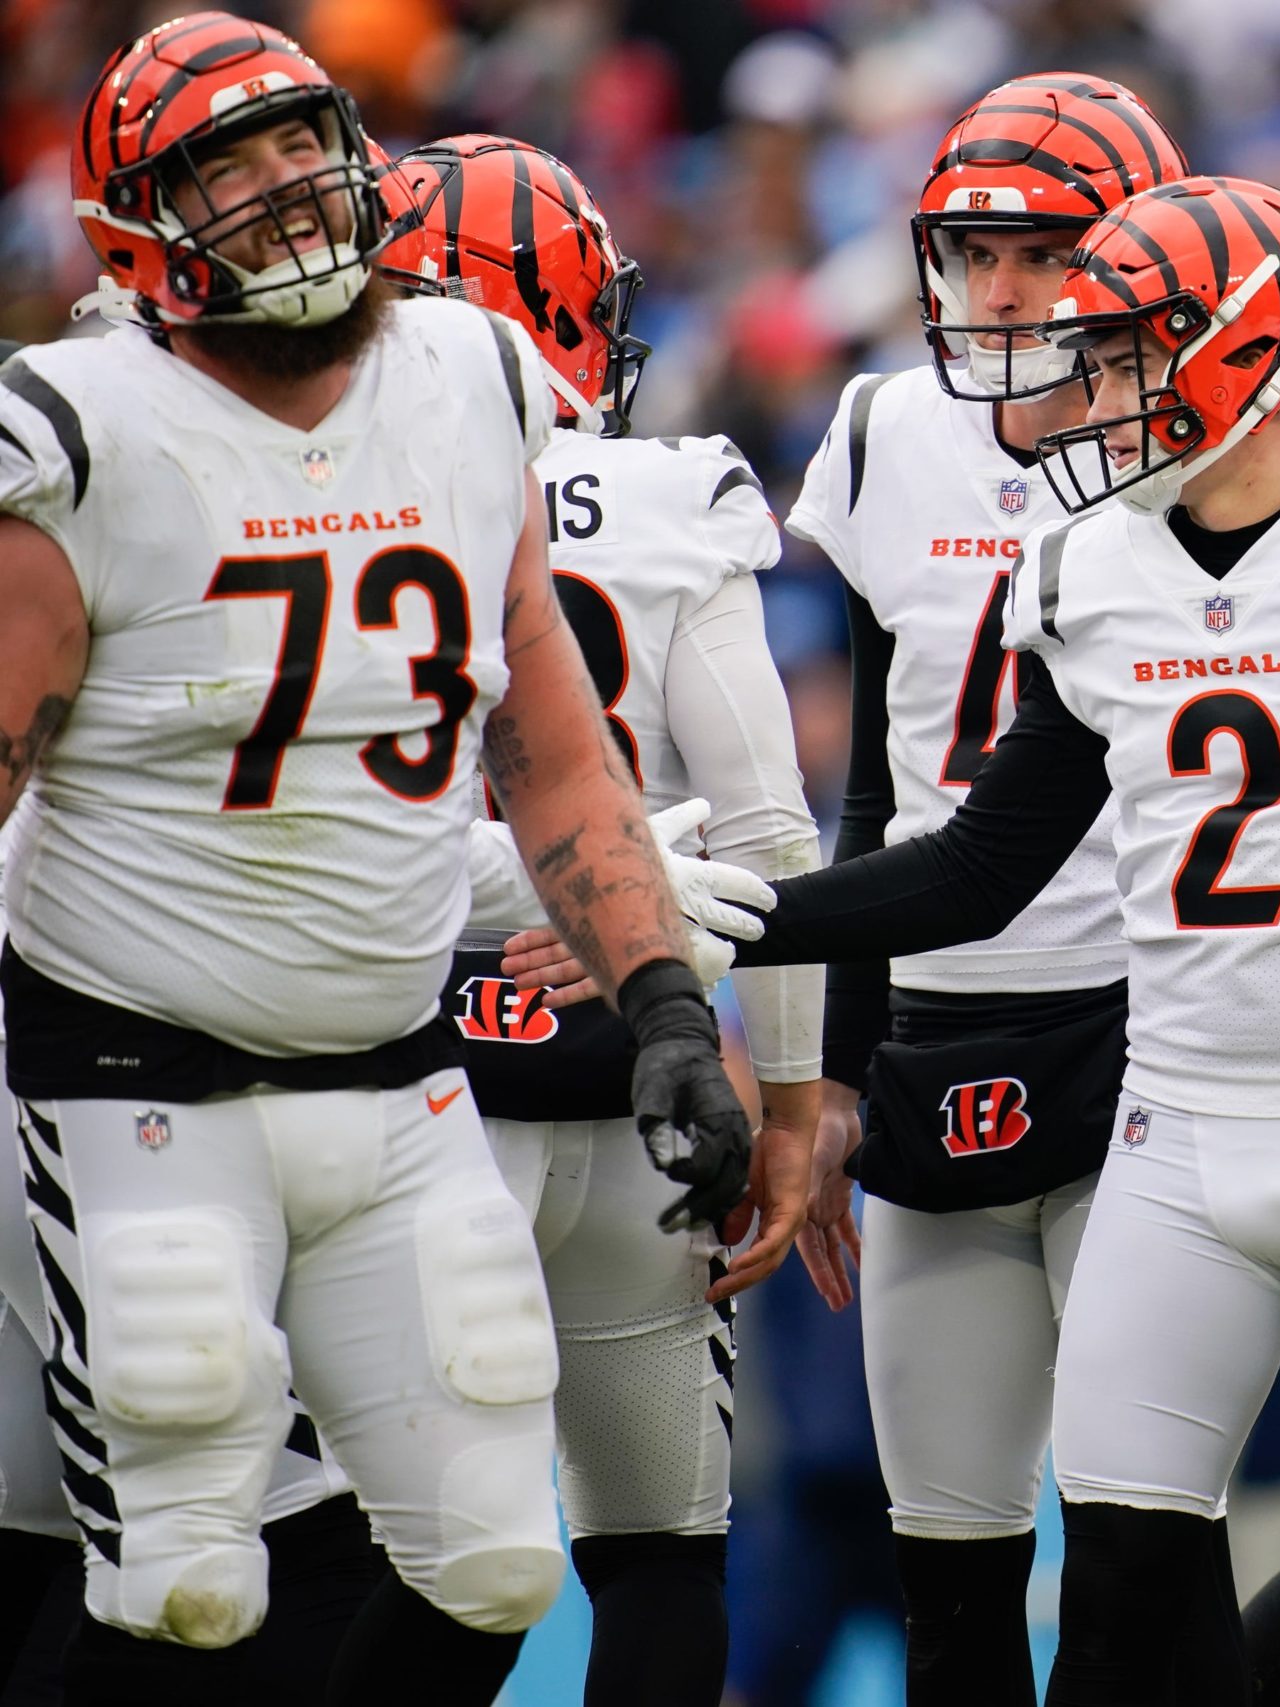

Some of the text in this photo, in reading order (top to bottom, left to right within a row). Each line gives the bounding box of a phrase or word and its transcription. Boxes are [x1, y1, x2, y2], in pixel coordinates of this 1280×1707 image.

[1002, 493, 1023, 510] NFL
[243, 505, 422, 540] BENGALS
[1208, 611, 1230, 628] NFL
[202, 543, 478, 812] 73
[1125, 1123, 1144, 1142] NFL
